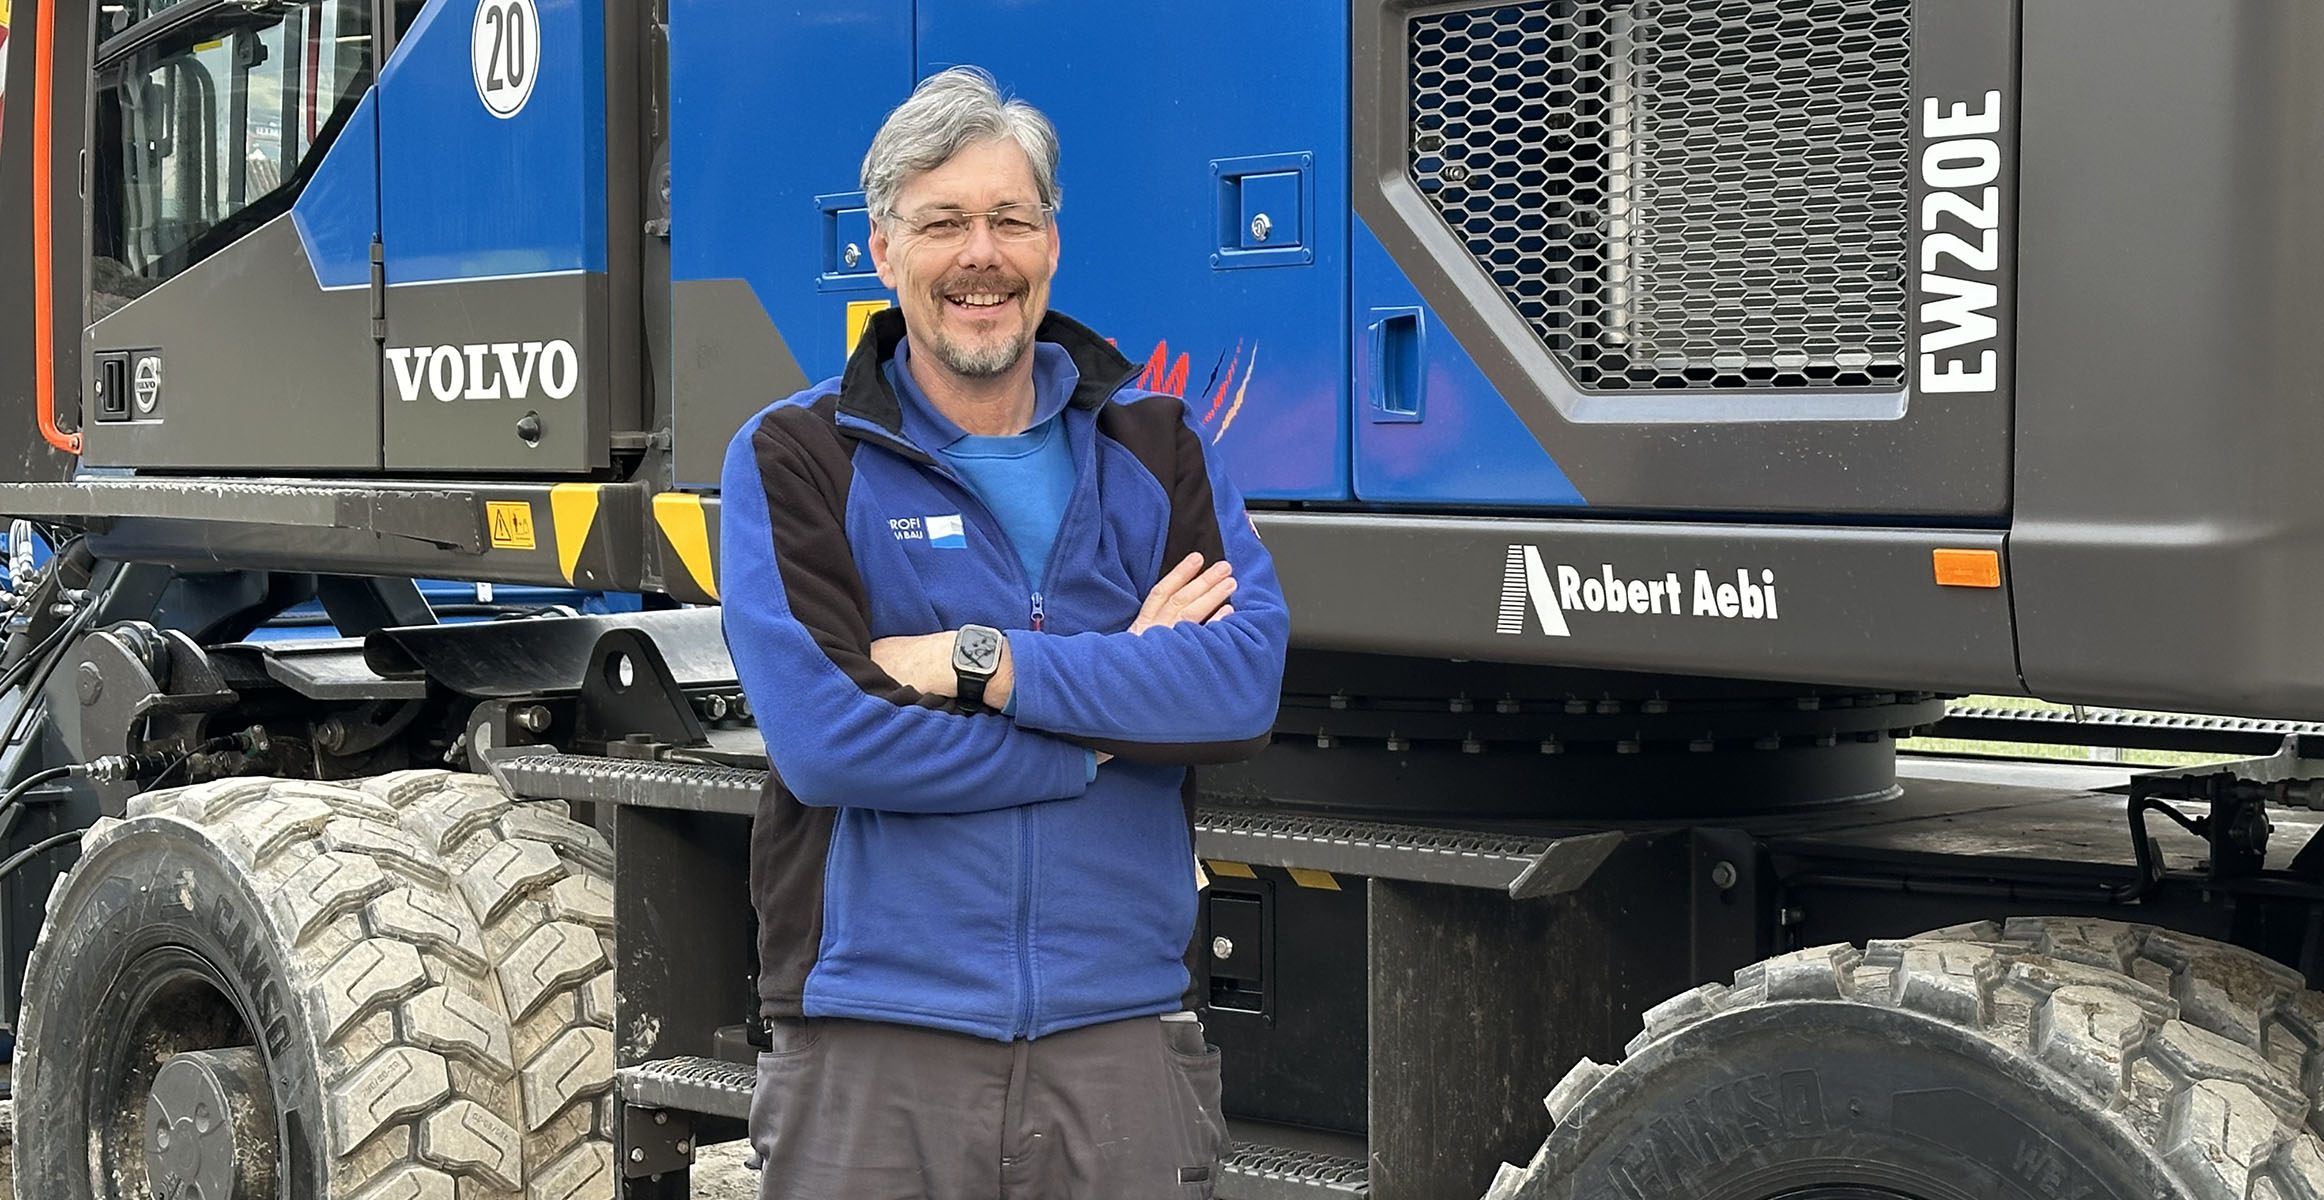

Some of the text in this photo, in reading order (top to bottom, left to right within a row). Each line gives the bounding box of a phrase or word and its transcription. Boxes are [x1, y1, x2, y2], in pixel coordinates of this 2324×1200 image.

[486, 1, 525, 92] 20
[1919, 89, 2001, 394] EW220E
[385, 339, 579, 402] VOLVO
[887, 517, 920, 530] ROFI
[904, 530, 923, 540] BAU
[1557, 563, 1682, 615] Robert
[1692, 568, 1779, 620] Aebi
[211, 893, 294, 1062] CAMSO
